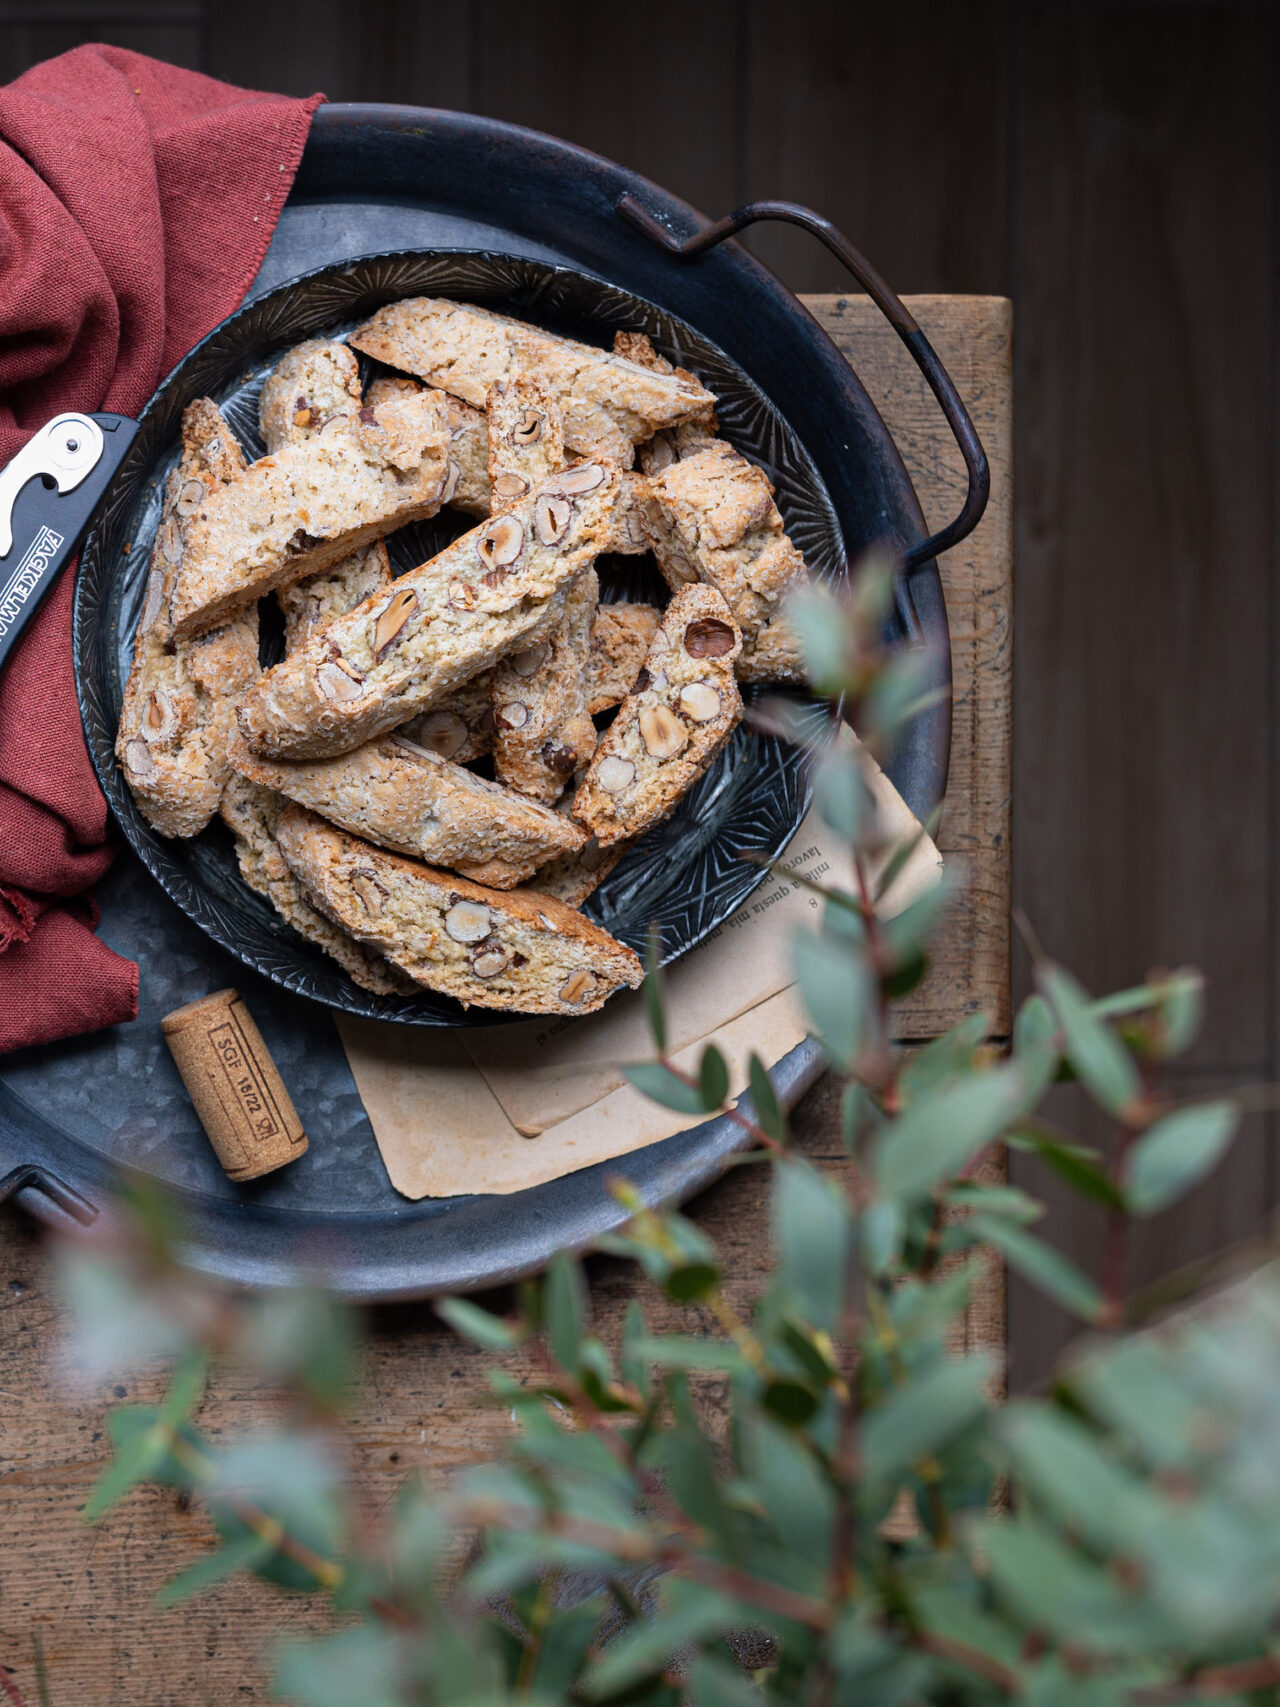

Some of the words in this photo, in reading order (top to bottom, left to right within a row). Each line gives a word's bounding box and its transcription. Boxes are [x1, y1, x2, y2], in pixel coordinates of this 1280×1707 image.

[805, 861, 830, 881] mile
[791, 880, 801, 890] a
[752, 885, 790, 913] questa
[808, 898, 819, 909] 8
[218, 1038, 242, 1069] SGF
